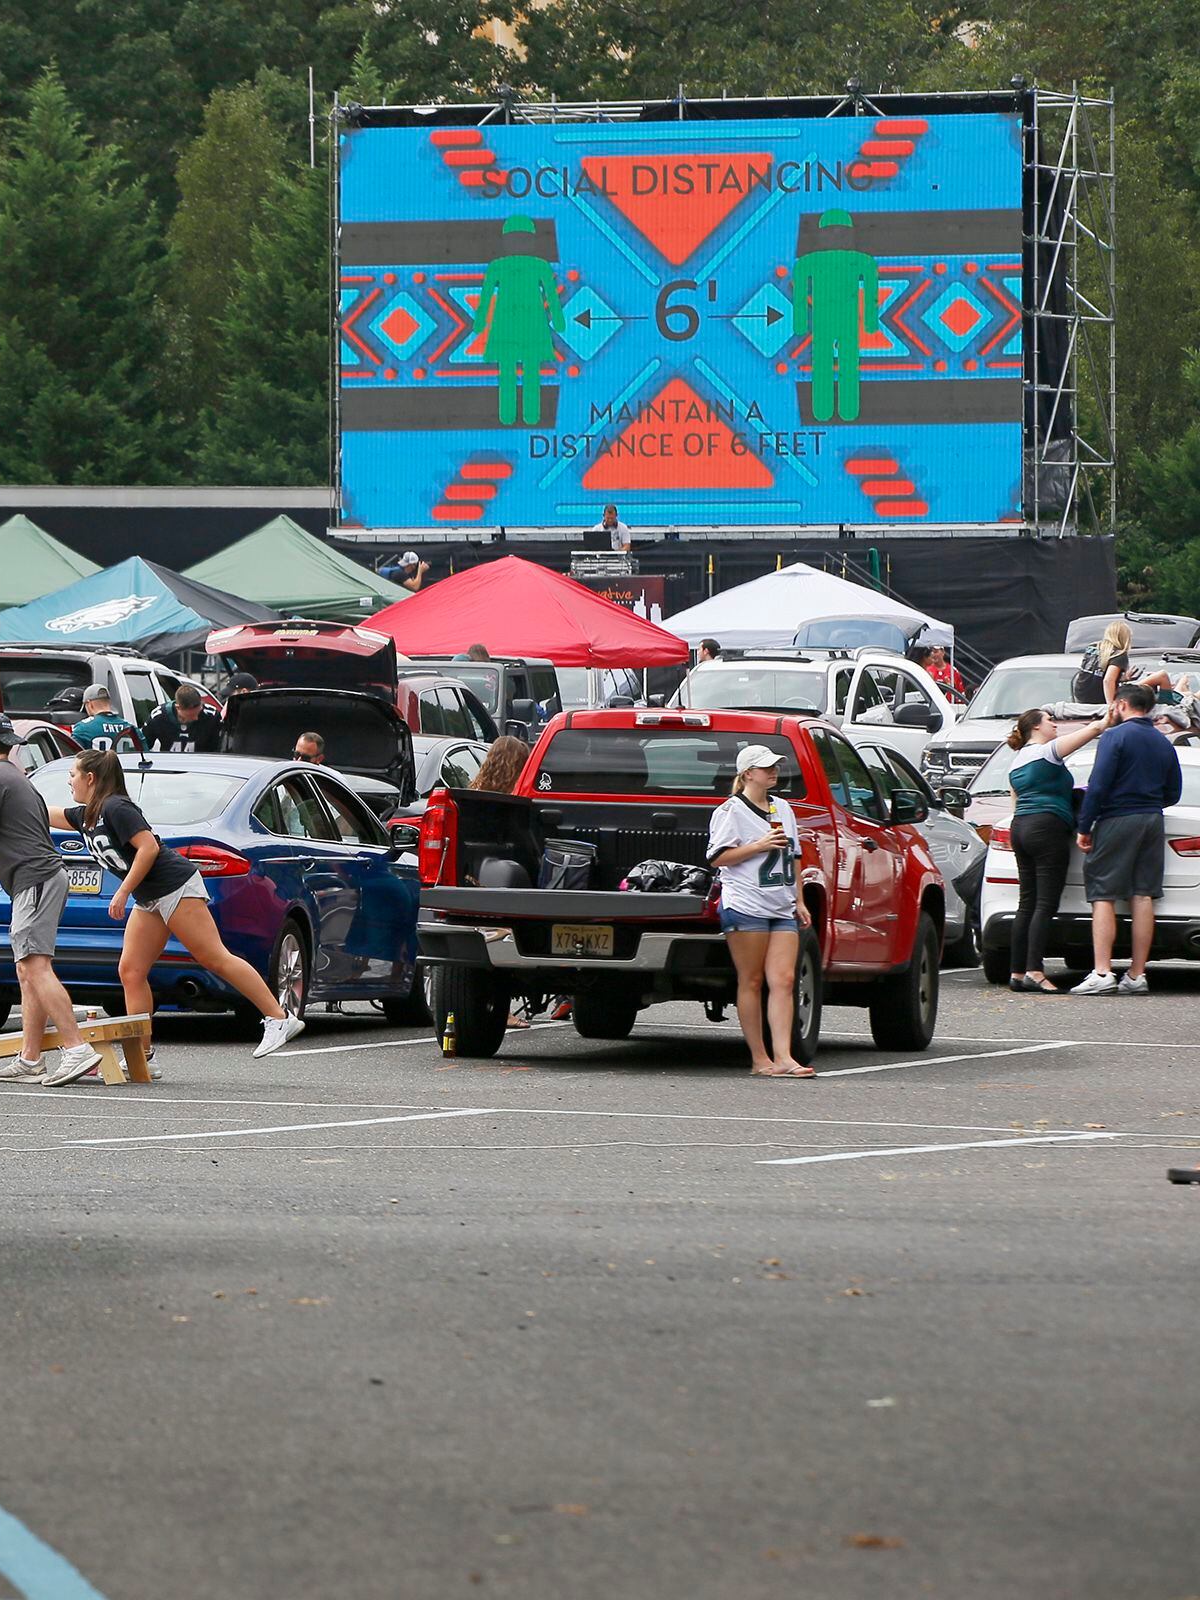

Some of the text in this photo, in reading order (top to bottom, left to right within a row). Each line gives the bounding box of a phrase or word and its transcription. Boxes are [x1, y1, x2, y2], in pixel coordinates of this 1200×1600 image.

[481, 160, 873, 199] SOCIAL DISTANCING
[655, 279, 717, 342] 6'
[590, 399, 764, 424] MAINTAIN A
[529, 431, 826, 459] DISTANCE OF 6 FEET
